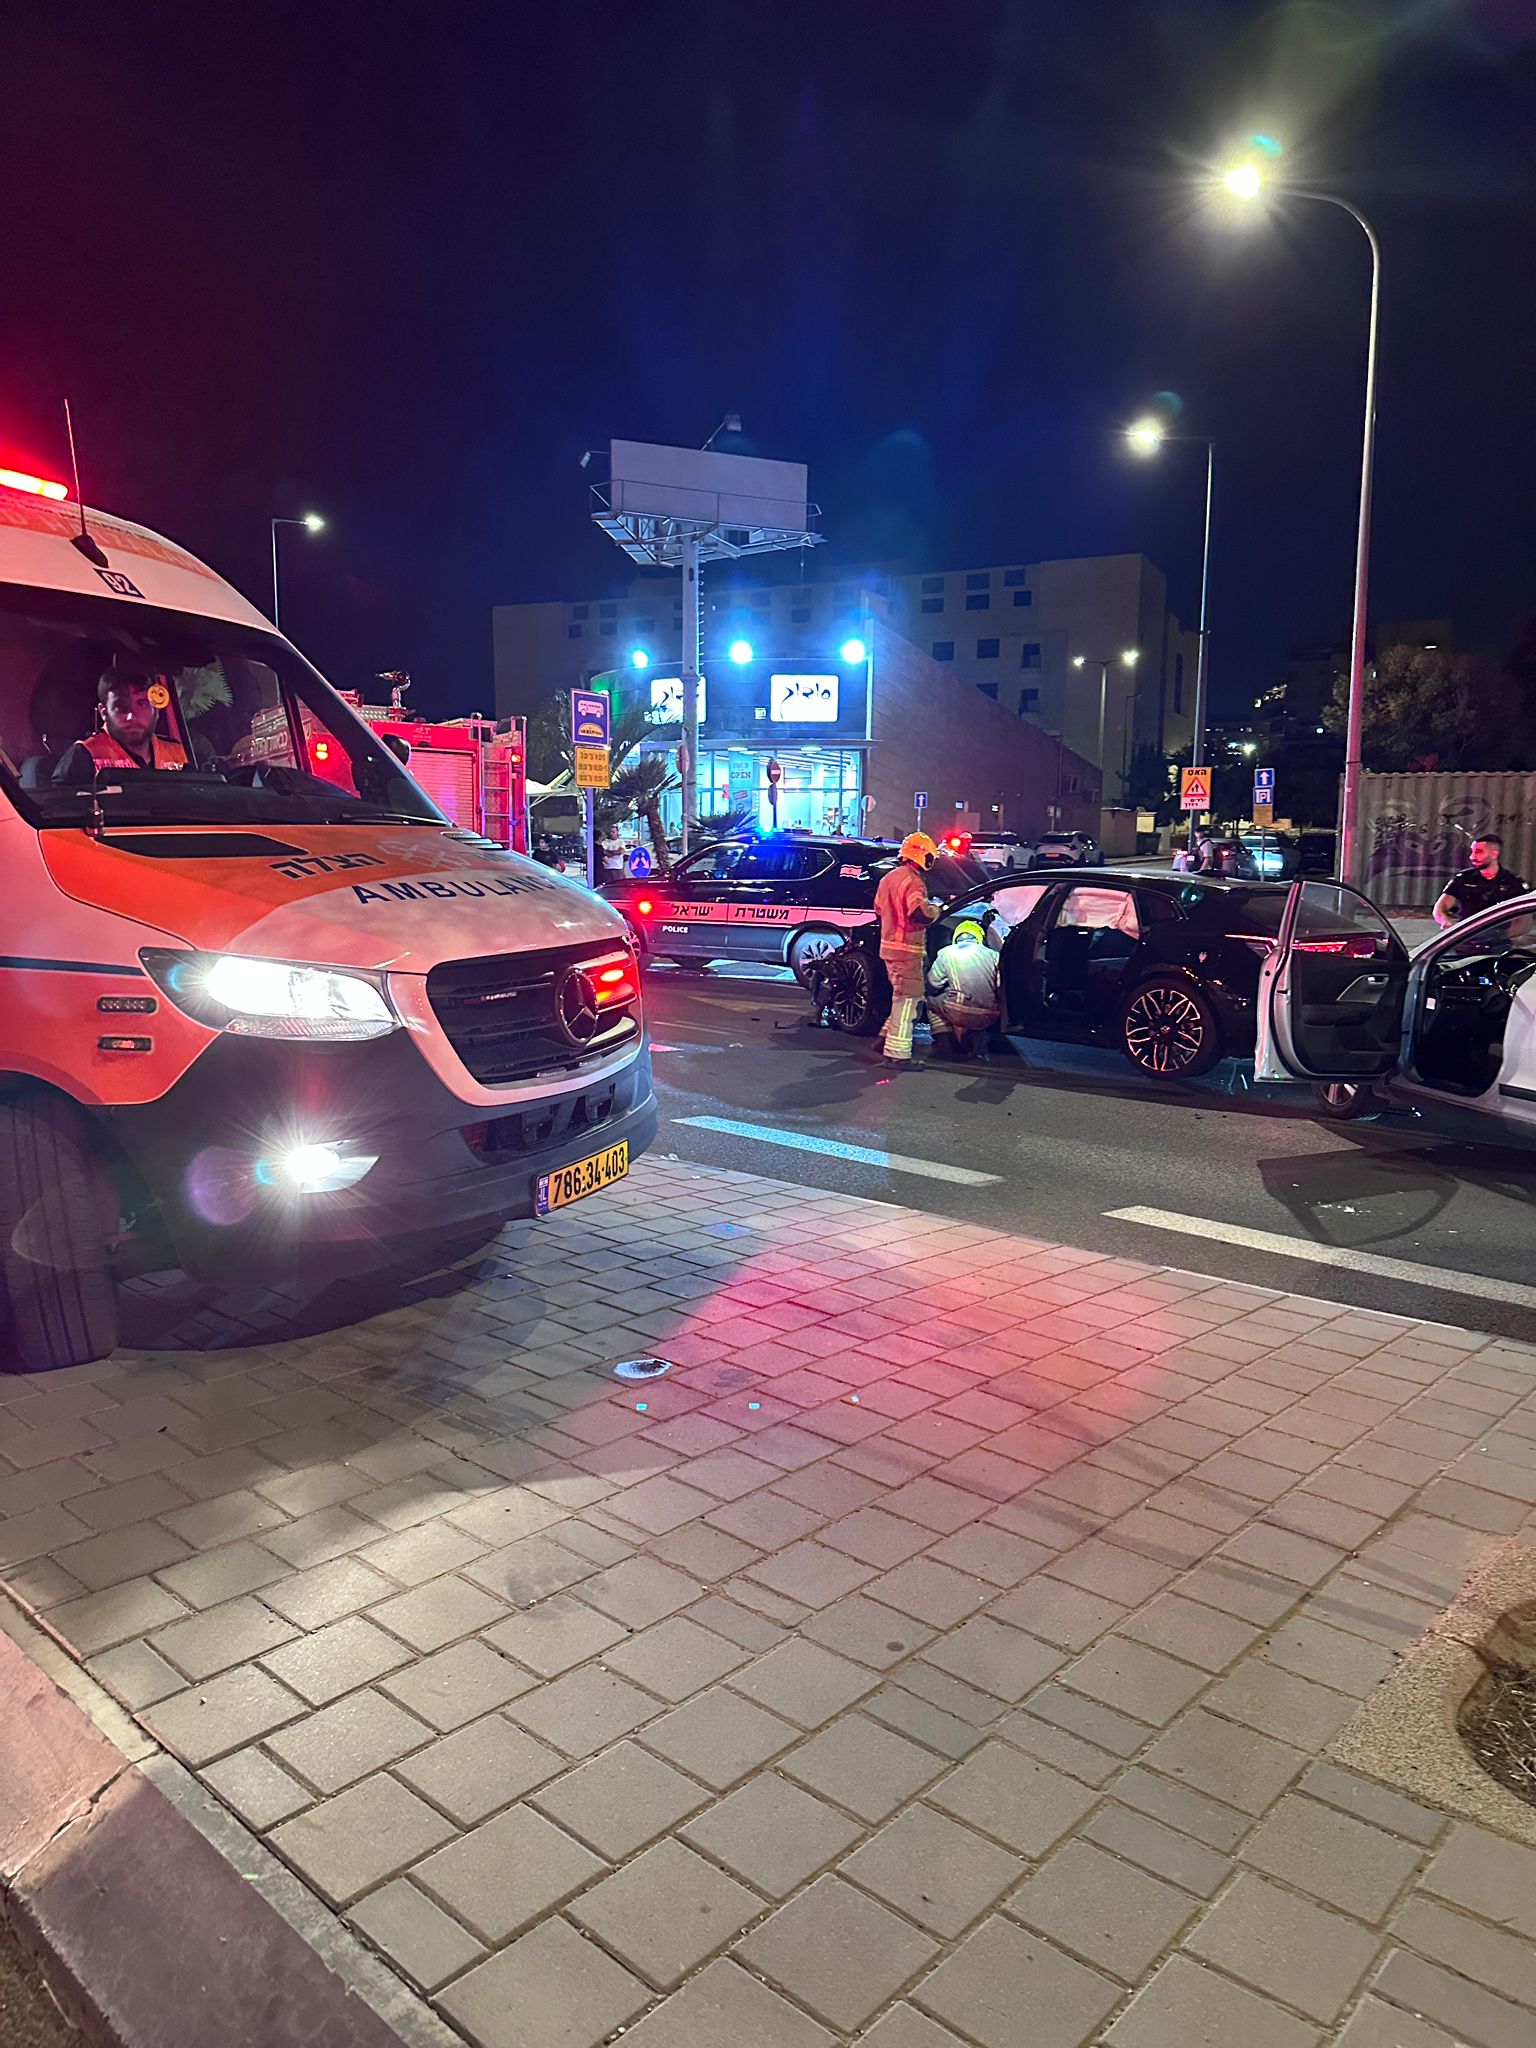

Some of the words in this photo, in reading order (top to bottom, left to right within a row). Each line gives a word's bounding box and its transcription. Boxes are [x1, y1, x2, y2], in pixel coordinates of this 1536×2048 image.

[103, 571, 140, 596] 92
[730, 771, 751, 779] OPEN
[269, 853, 386, 880] הצלה
[670, 903, 714, 917] ישראל
[734, 907, 790, 920] משטרת
[662, 925, 689, 934] POLICE
